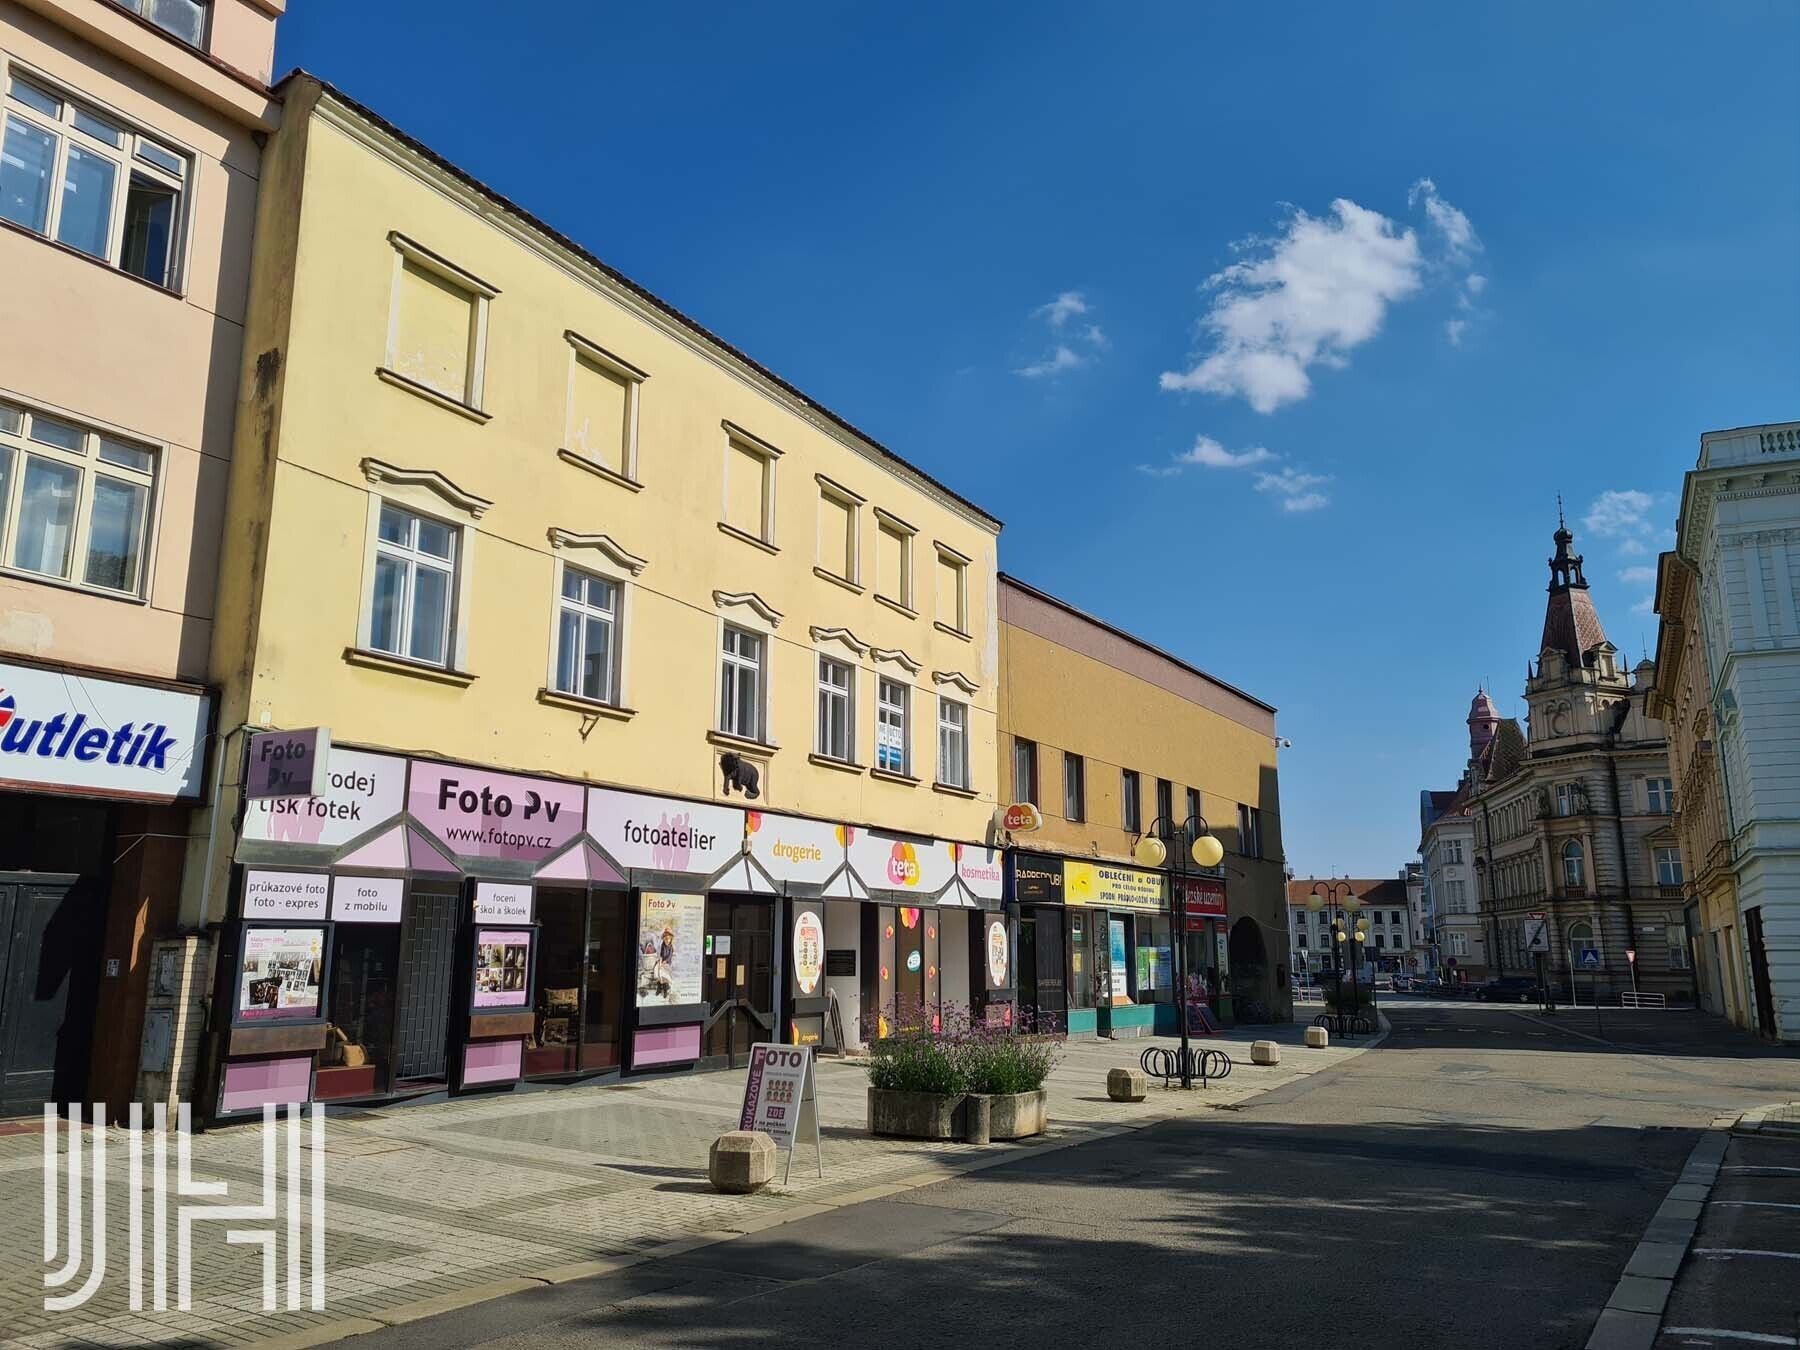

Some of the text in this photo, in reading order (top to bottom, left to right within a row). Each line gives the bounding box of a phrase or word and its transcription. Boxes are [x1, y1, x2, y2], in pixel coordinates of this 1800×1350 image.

[260, 739, 306, 762] Foto
[327, 770, 376, 797] odej
[307, 797, 361, 821] fotek
[437, 778, 561, 822] Foto Pv
[1007, 813, 1033, 826] teta
[446, 826, 552, 850] www.fotopv.cz
[623, 819, 716, 850] fotoatelier
[772, 840, 822, 863] drogerie
[891, 856, 916, 877] teta
[961, 864, 1000, 881] kosmetika
[250, 881, 326, 896] průkazové foto
[357, 888, 378, 898] foto
[253, 898, 275, 907] foto
[285, 900, 319, 910] expres
[344, 901, 388, 911] z mobilu
[480, 904, 495, 914] škol
[503, 905, 526, 915] školek
[648, 899, 665, 908] Foto
[754, 1049, 802, 1068] FOTO
[743, 1069, 762, 1131] RŮKAZOVÉ
